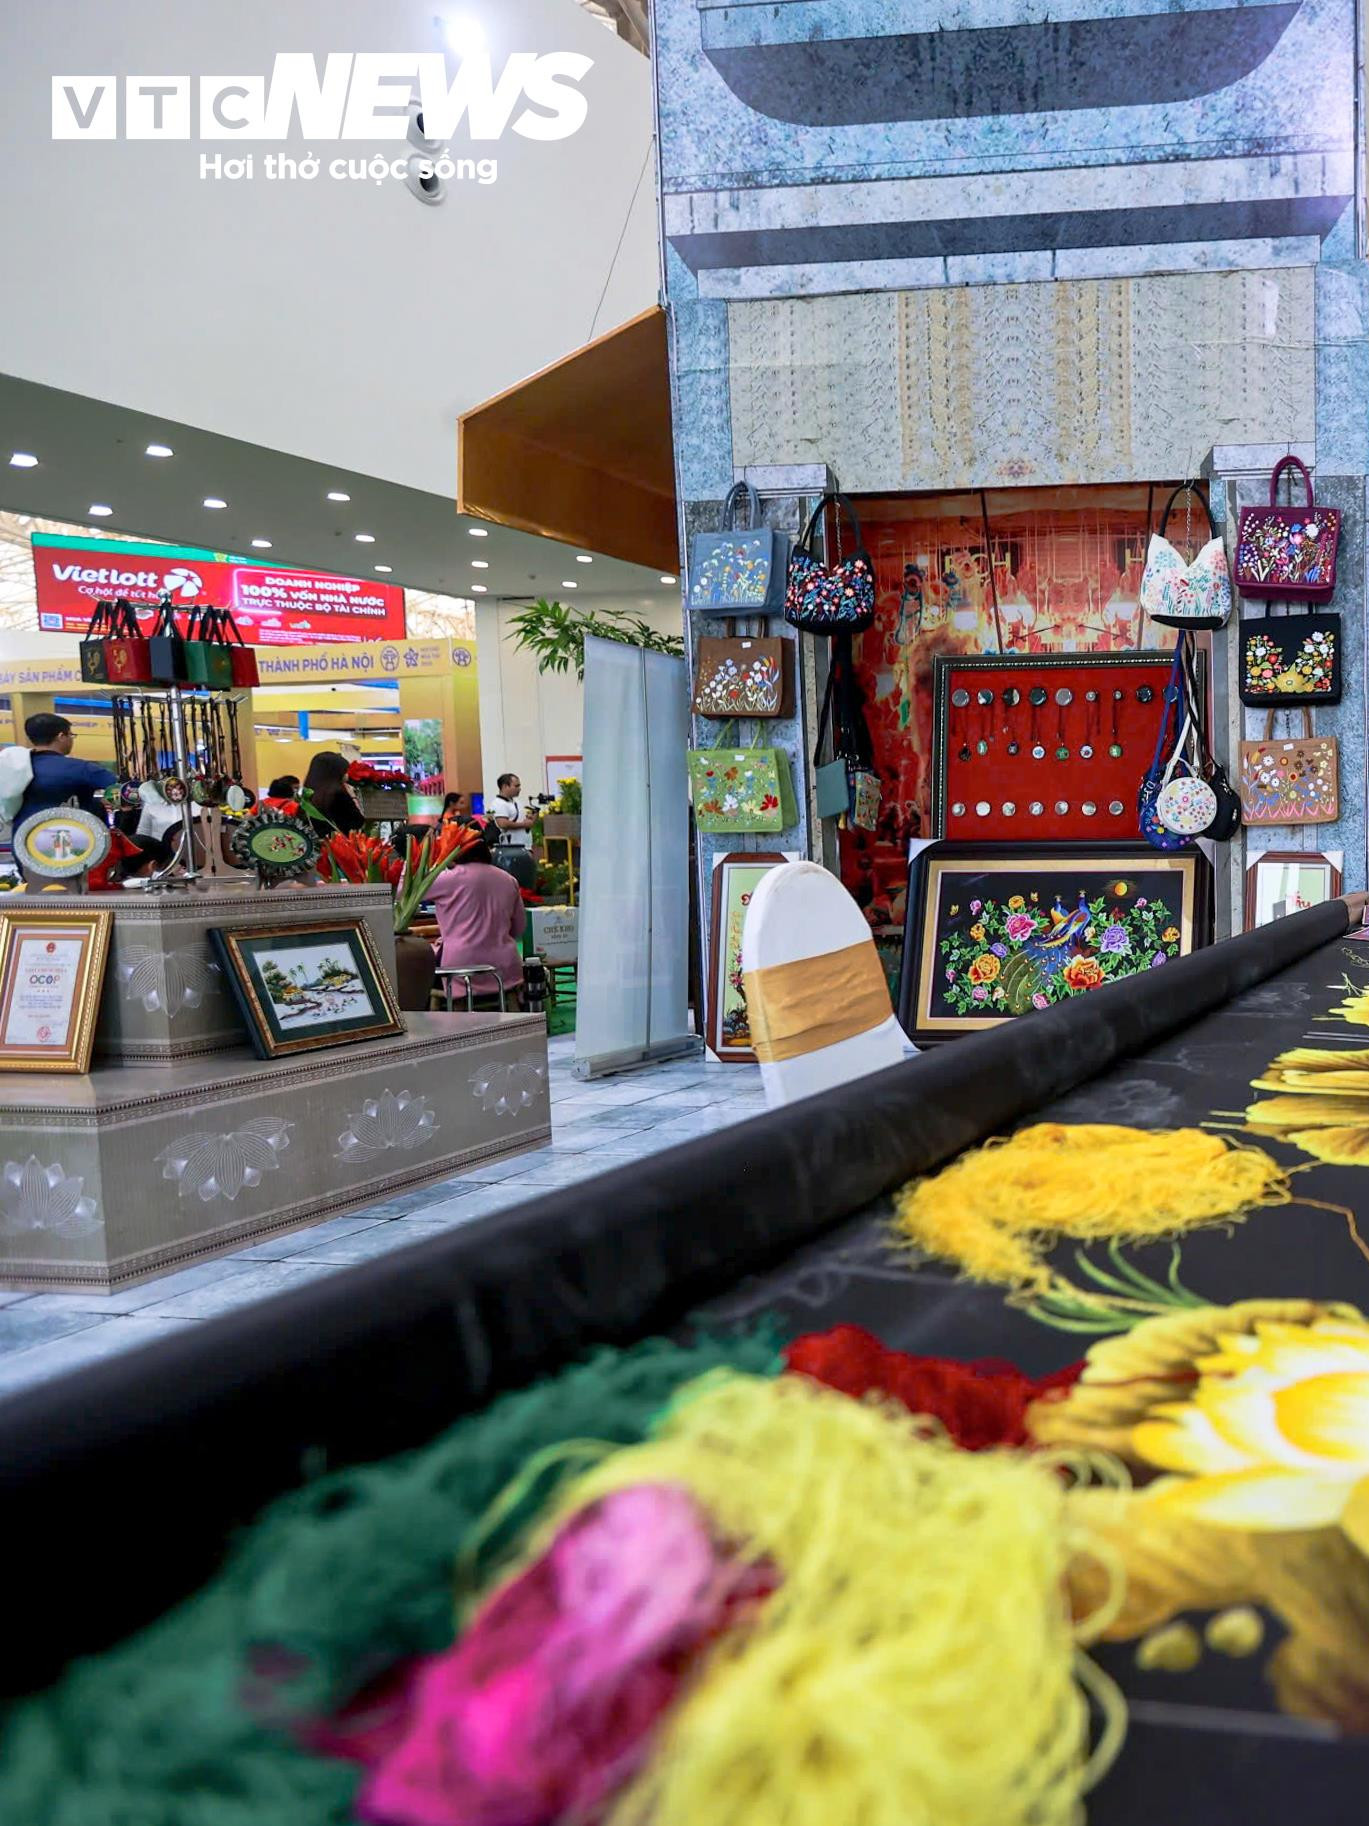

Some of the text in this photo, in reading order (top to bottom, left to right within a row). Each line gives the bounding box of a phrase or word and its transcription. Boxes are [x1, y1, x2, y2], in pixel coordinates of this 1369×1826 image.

[52, 563, 158, 588] Vietlott
[265, 577, 360, 593] DOANH NGHIỆP
[241, 584, 385, 606] 100% VỐN NHÀ NƯỚC
[242, 597, 386, 616] TRỰC THUỘC BỘ TÀI CHÍNH
[259, 651, 375, 673] THÀNH PHỐ HÀ NỘI
[42, 664, 73, 683] PHẨM
